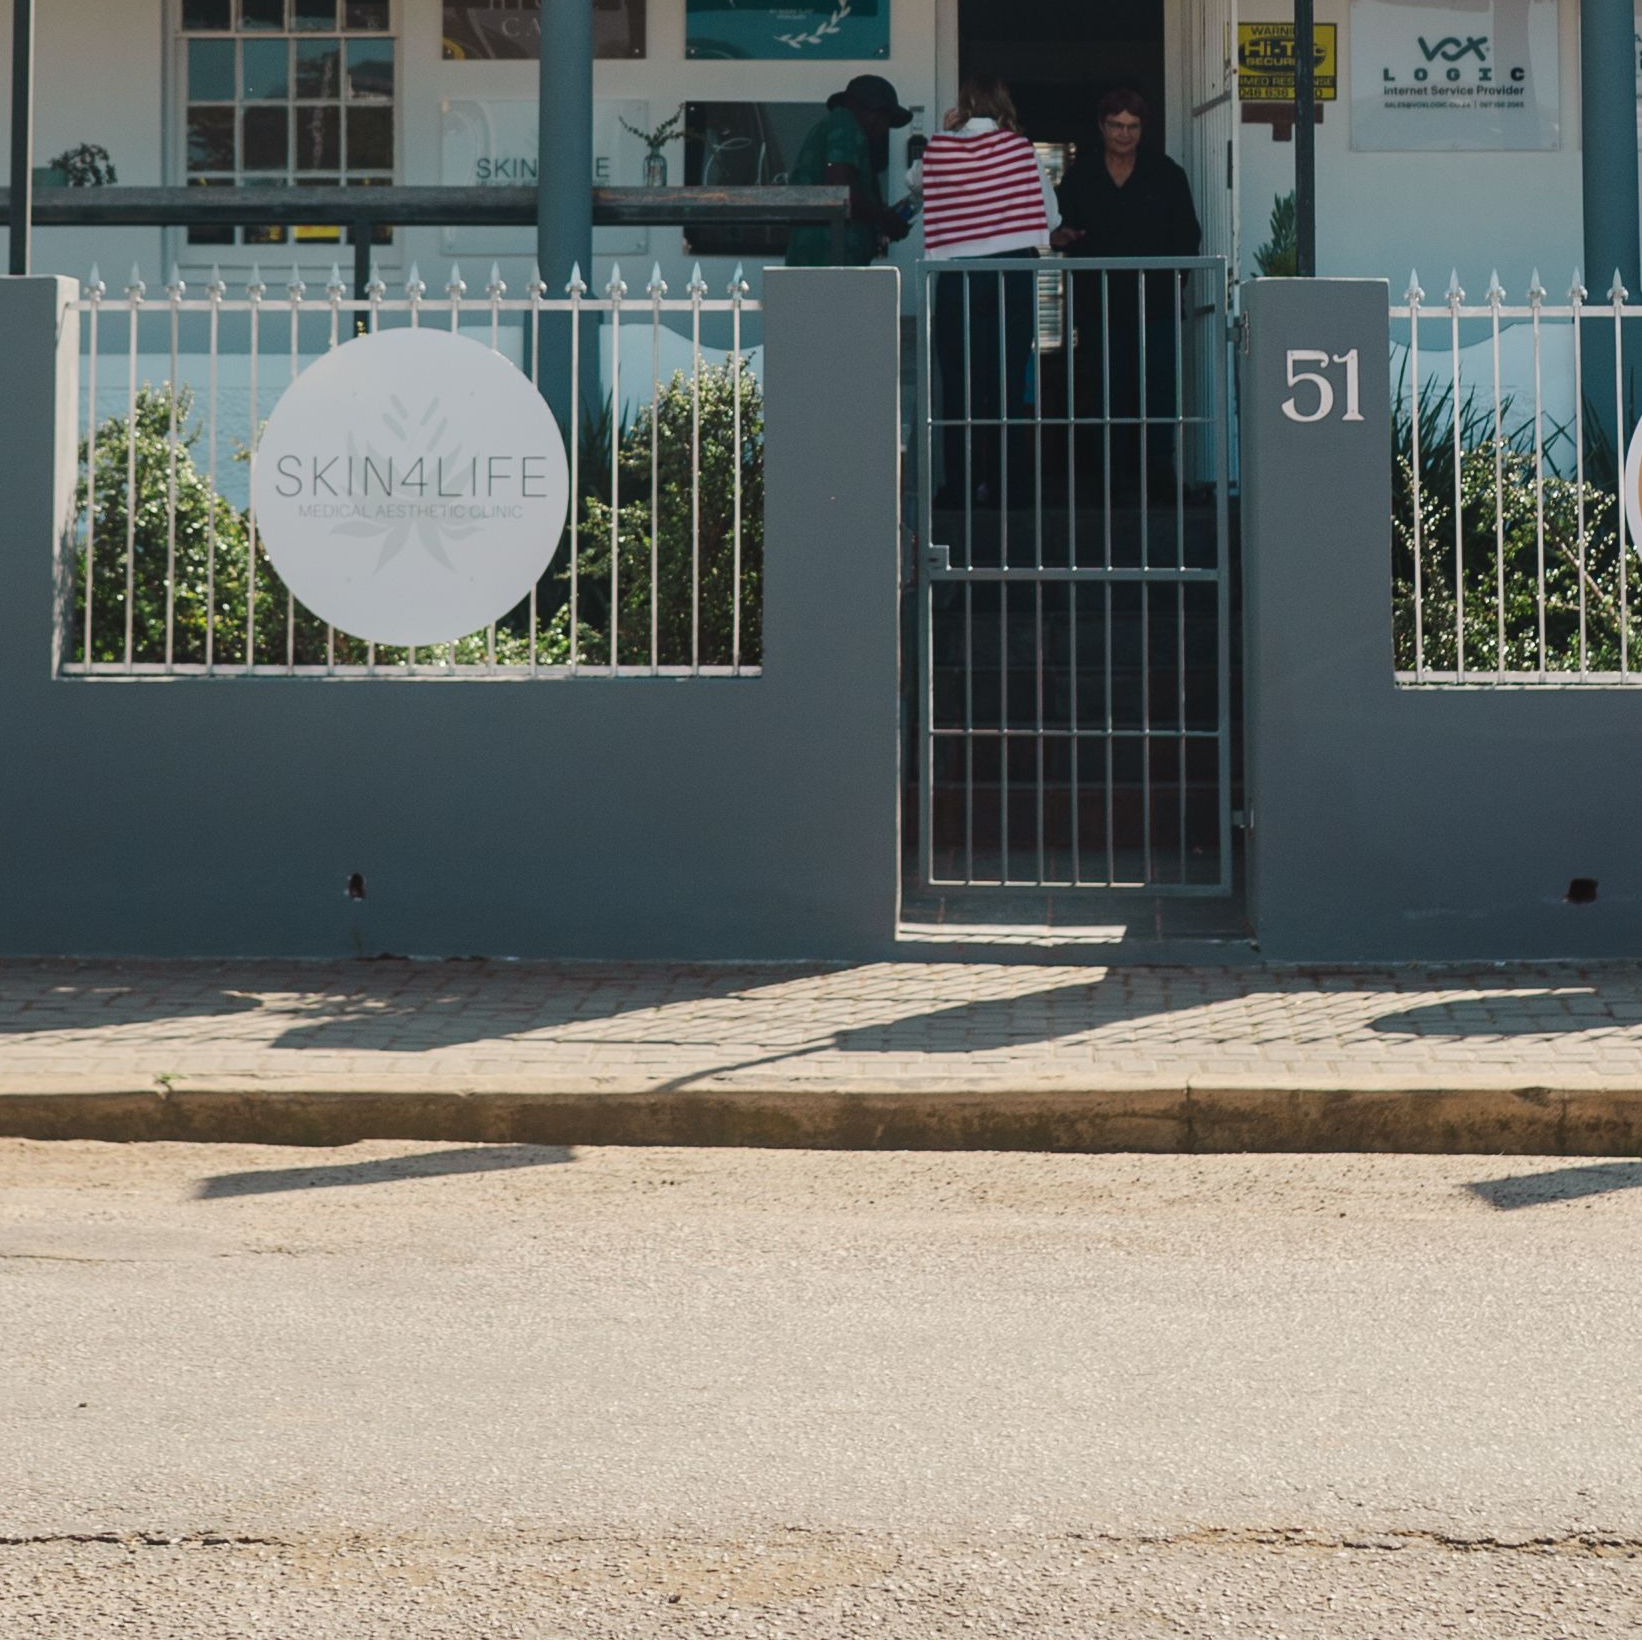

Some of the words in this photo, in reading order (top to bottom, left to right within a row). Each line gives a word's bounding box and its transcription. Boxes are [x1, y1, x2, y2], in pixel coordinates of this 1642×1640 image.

[1251, 26, 1296, 35] WARNI
[1417, 36, 1488, 62] VOX
[1246, 57, 1296, 66] SECURI
[1383, 67, 1525, 82] LOGIC
[1431, 86, 1473, 95] Service
[1476, 86, 1524, 95] Provider
[476, 157, 611, 179] SKINE
[1281, 348, 1365, 422] 51
[275, 454, 548, 498] SKIN4LIFE
[299, 504, 367, 518] MEDICAL
[375, 504, 467, 518] AESTHETIC
[469, 504, 523, 518] CLINIC
